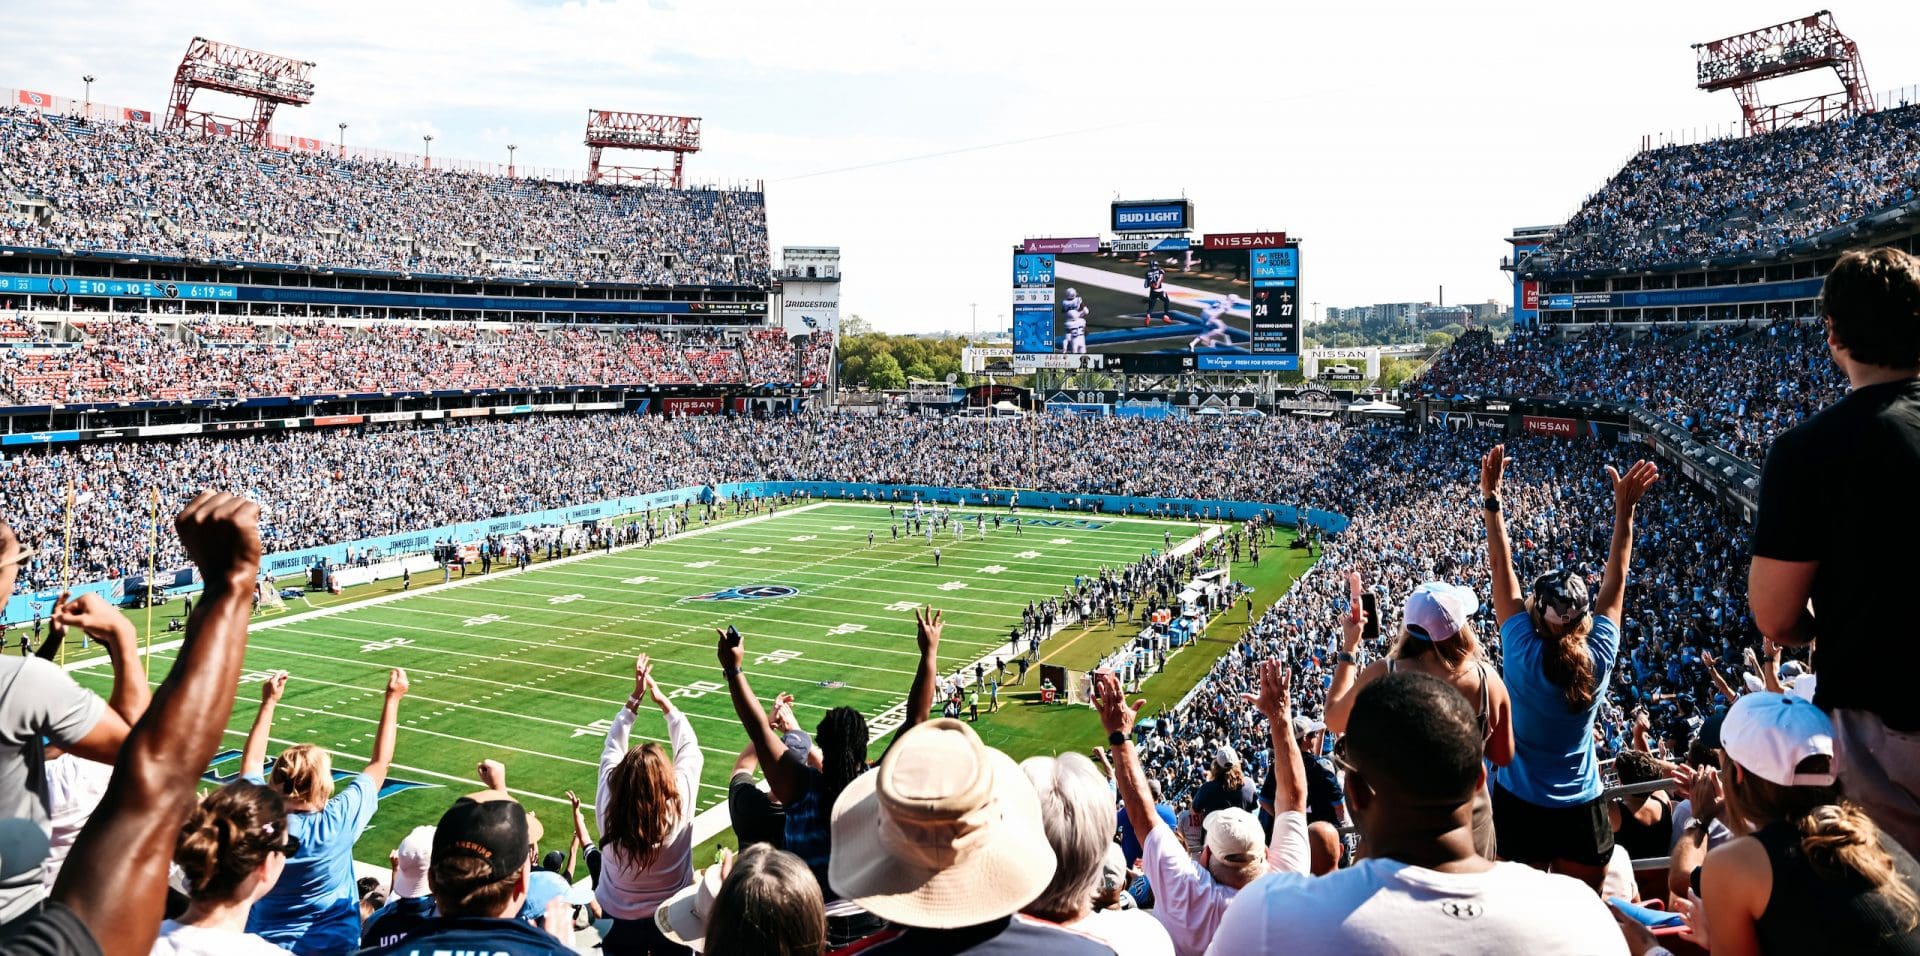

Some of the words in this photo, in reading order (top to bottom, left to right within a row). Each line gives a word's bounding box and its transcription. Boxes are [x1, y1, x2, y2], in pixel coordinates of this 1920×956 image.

[1120, 213, 1143, 222] BUD
[1144, 211, 1178, 221] LIGHT
[1113, 241, 1148, 250] Pinnacle
[1214, 236, 1274, 246] NISSAN
[1018, 274, 1028, 282] 10
[1040, 274, 1050, 282] 10
[92, 282, 106, 293] 10
[126, 284, 140, 294] 10
[191, 287, 214, 298] 6:19
[1256, 304, 1268, 316] 24
[1282, 304, 1292, 316] 27
[1529, 421, 1570, 432] NISSAN
[390, 538, 414, 550] TENNESSEE
[415, 536, 430, 547] TOUGH
[272, 556, 300, 570] TENNESSEE
[884, 600, 922, 612] 50
[826, 623, 868, 636] 40
[360, 638, 416, 652] 20
[754, 649, 804, 665] 30
[667, 680, 725, 700] 20
